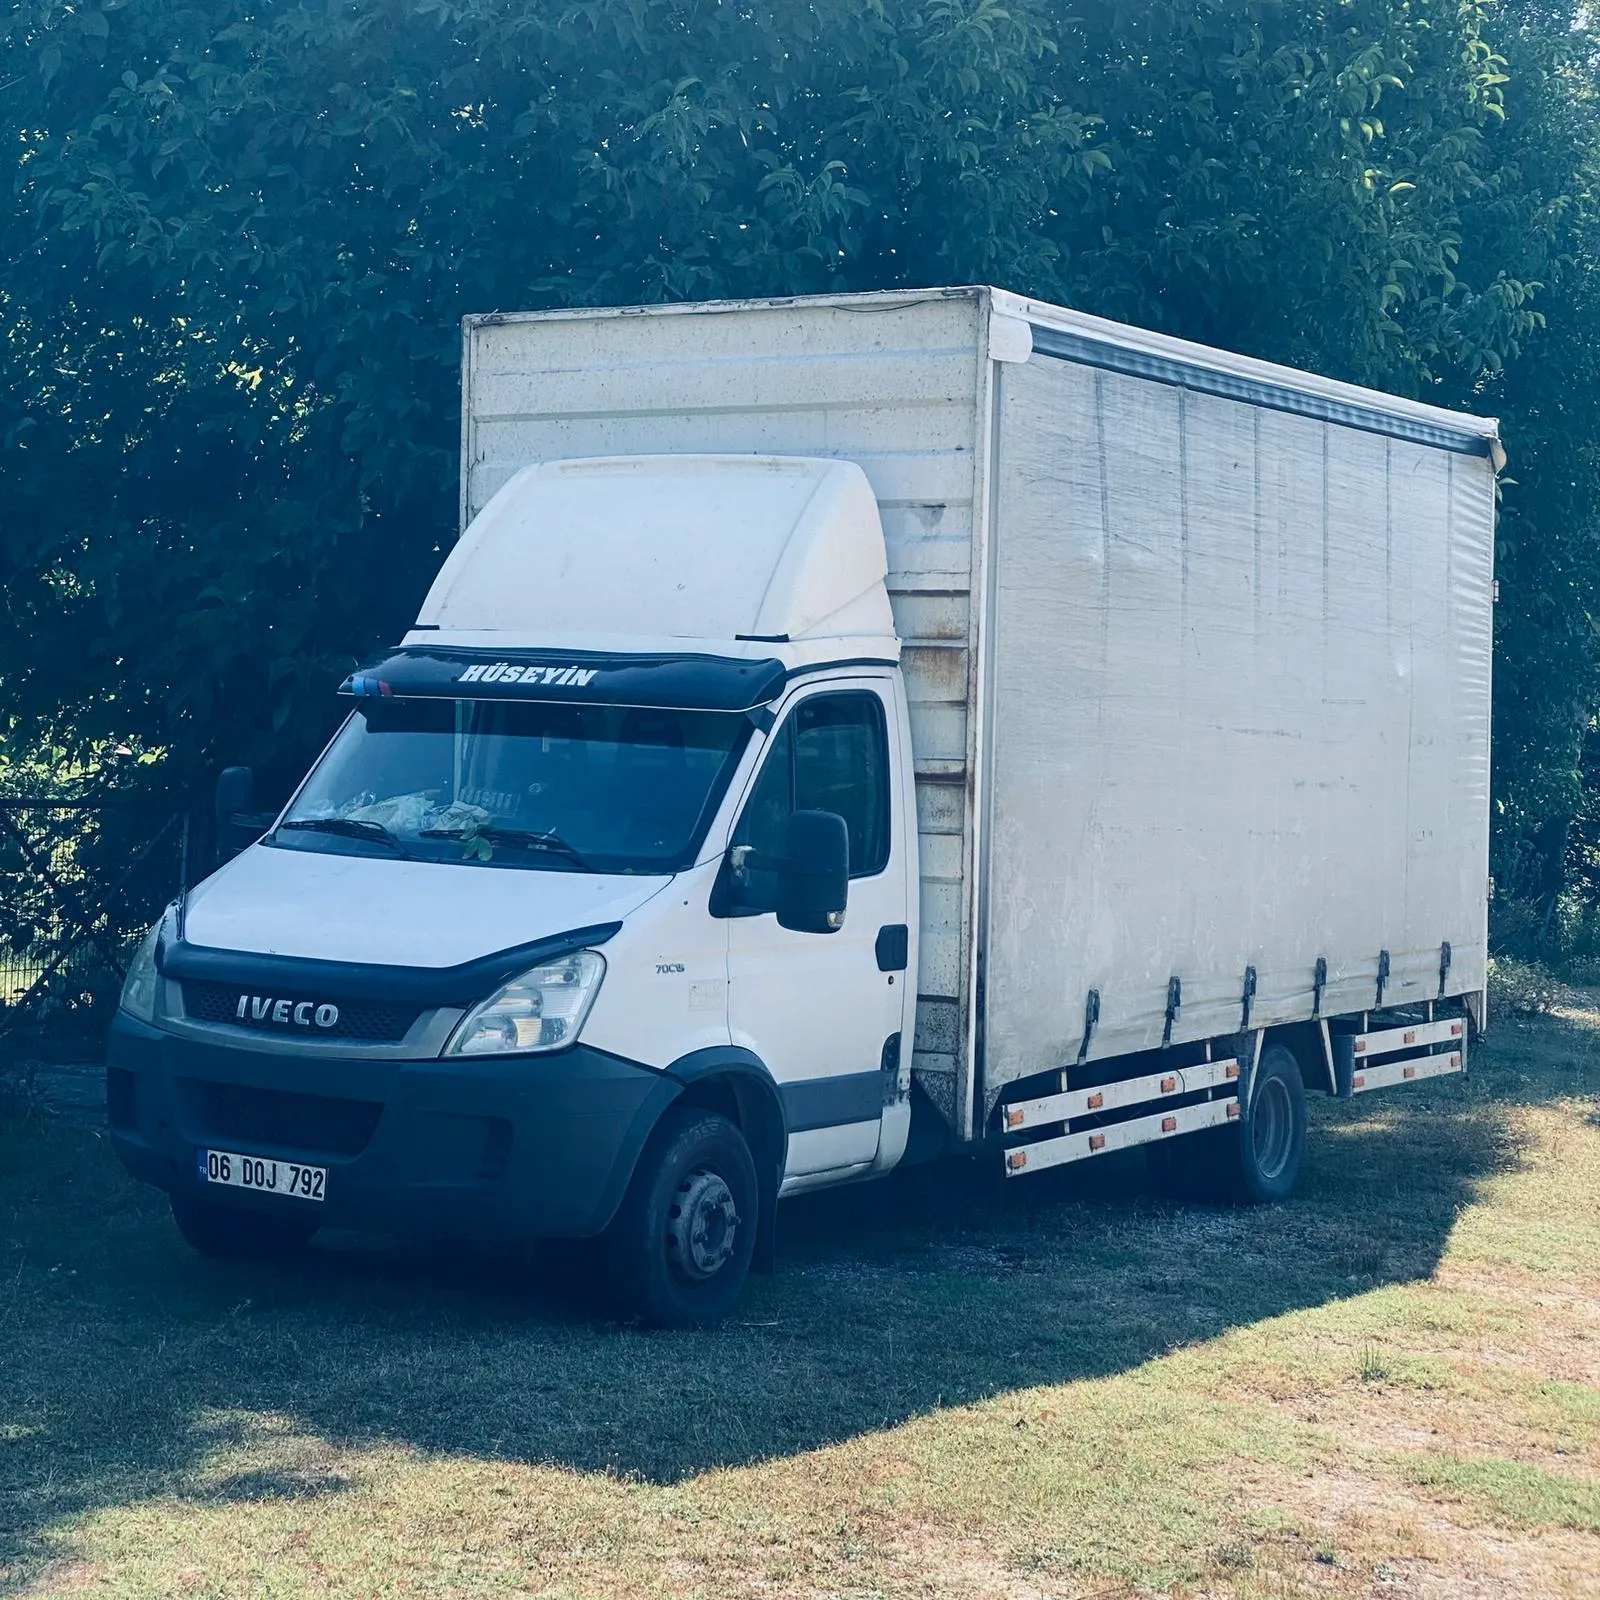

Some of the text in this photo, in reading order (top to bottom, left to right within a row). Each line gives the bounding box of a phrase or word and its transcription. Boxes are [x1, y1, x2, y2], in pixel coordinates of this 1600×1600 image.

[457, 662, 599, 687] HÜSEYİN
[235, 995, 339, 1028] IVECO
[198, 1165, 208, 1175] TR
[208, 1153, 325, 1199] 06 DOJ 792
